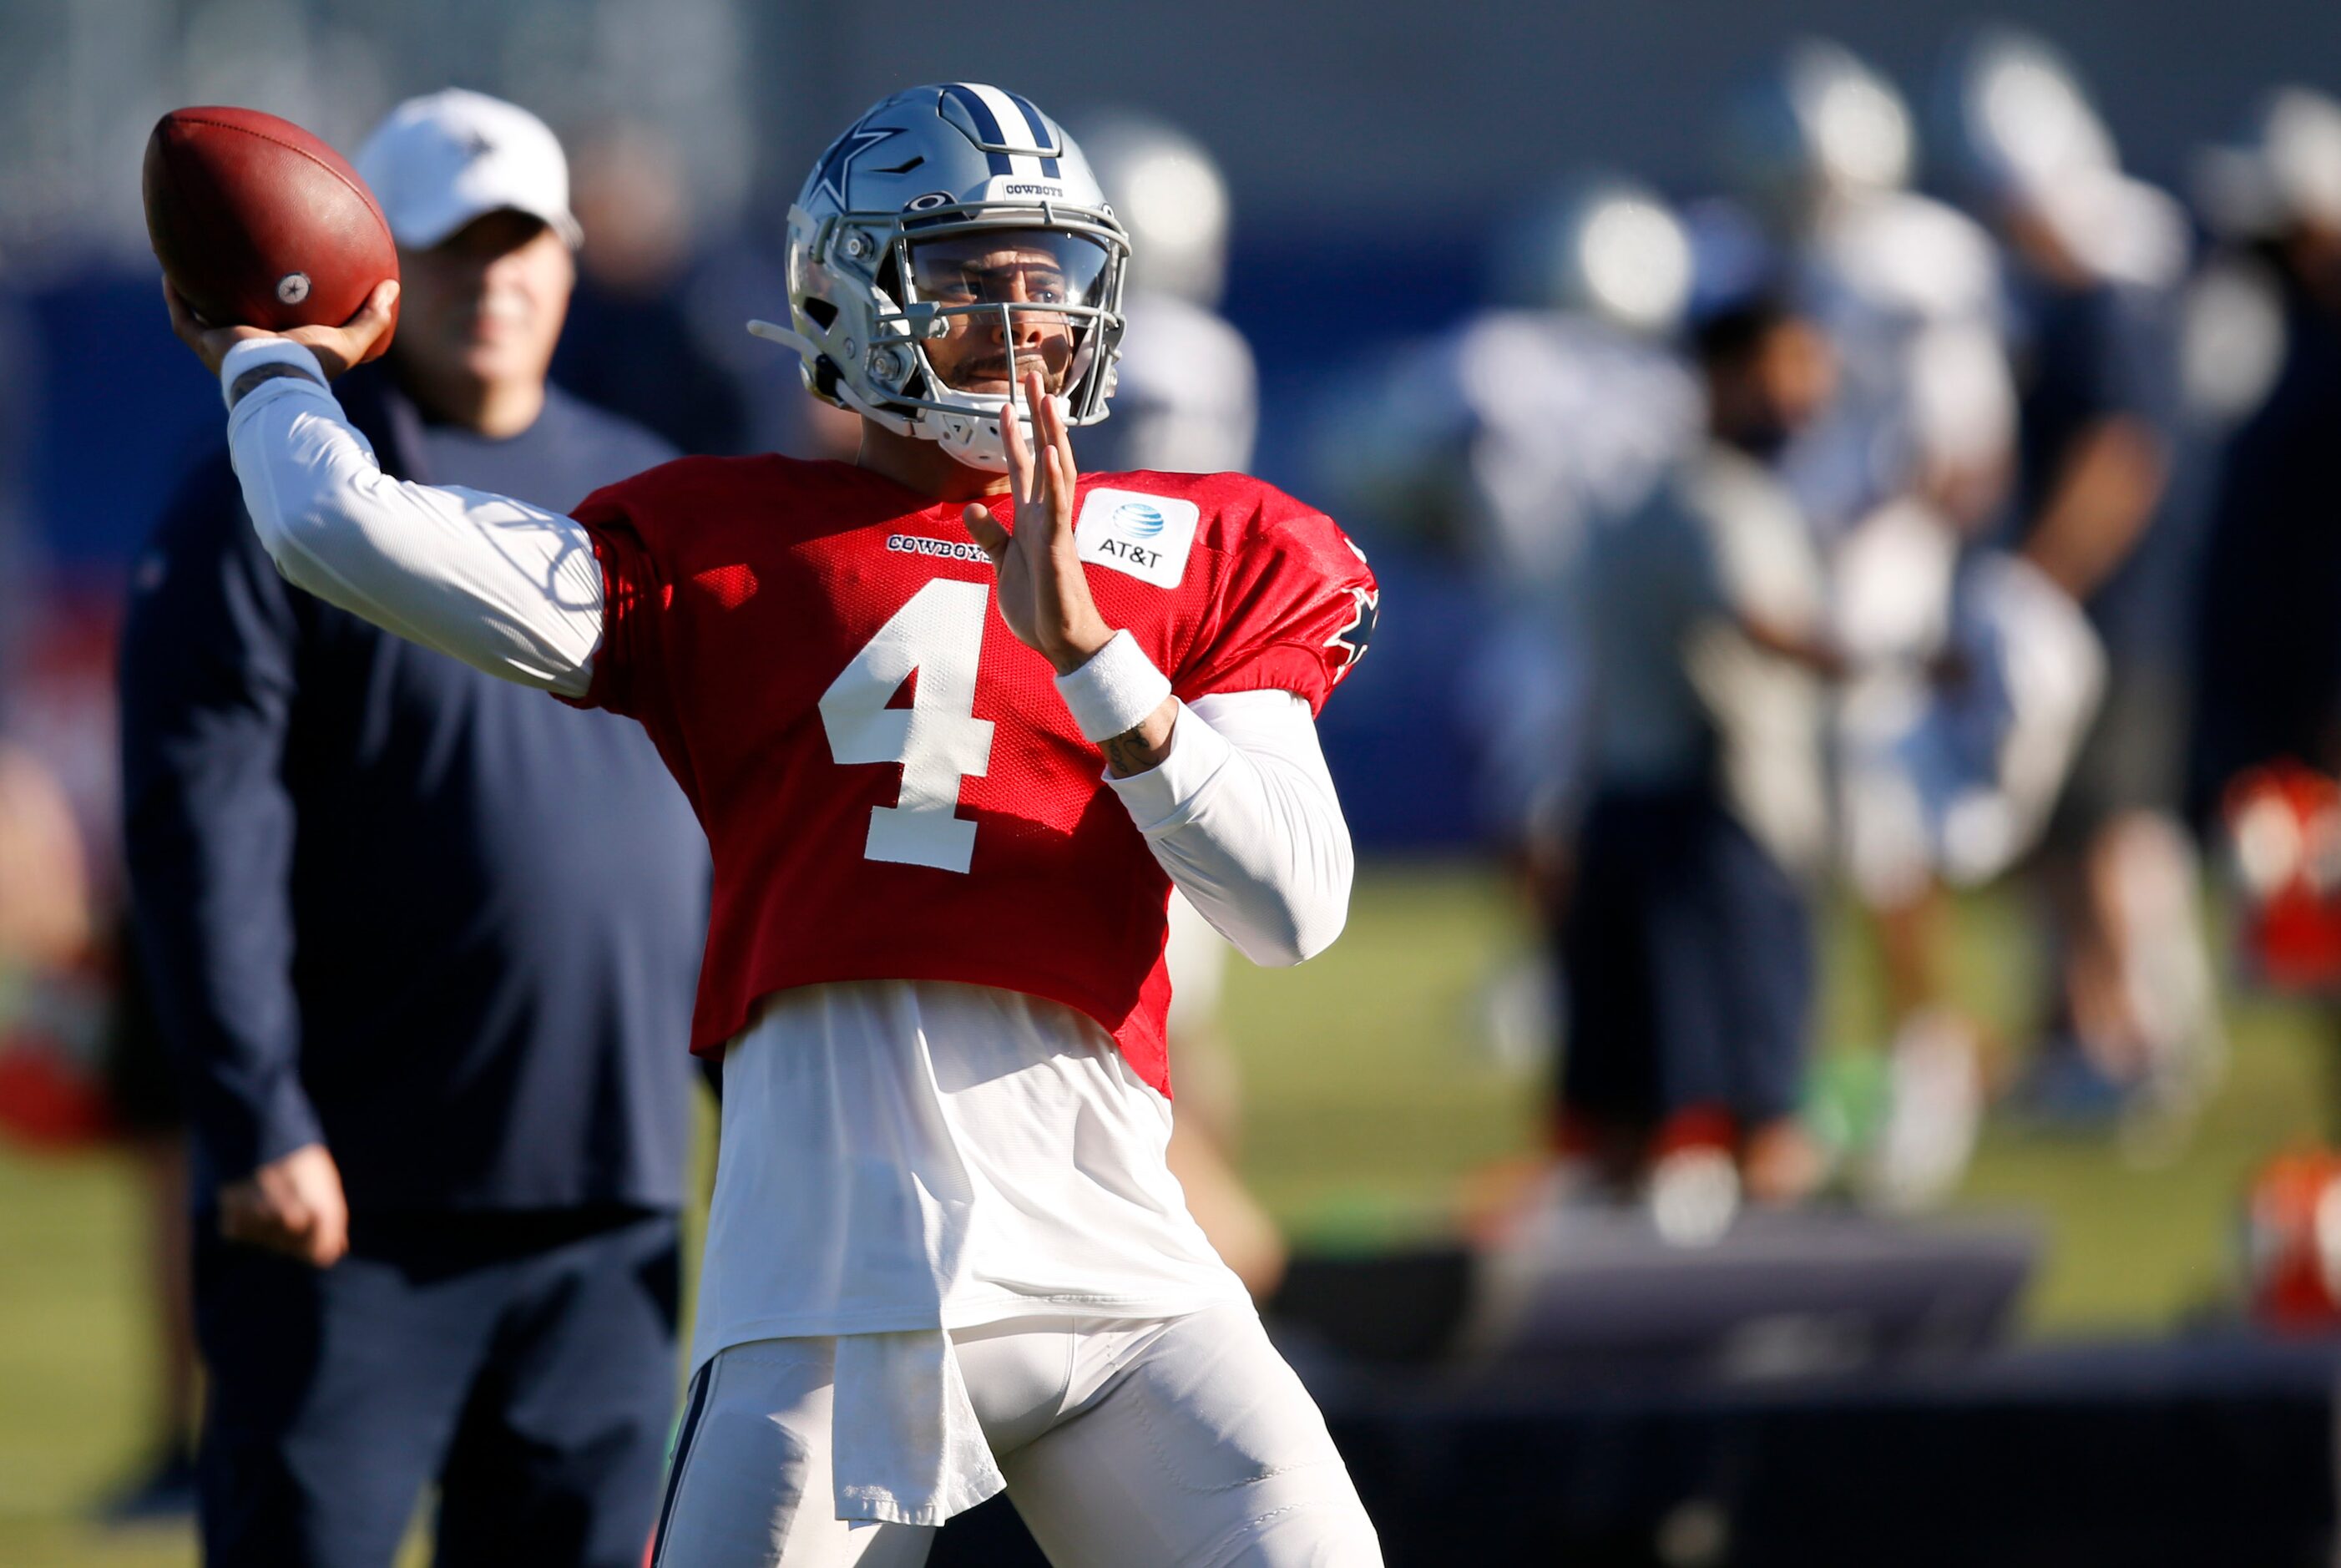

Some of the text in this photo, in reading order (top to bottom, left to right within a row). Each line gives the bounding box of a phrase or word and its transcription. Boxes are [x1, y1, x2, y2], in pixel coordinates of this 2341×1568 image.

[1006, 185, 1063, 197] COWBOYS
[1099, 539, 1162, 568] AT&T
[817, 577, 995, 874] 4
